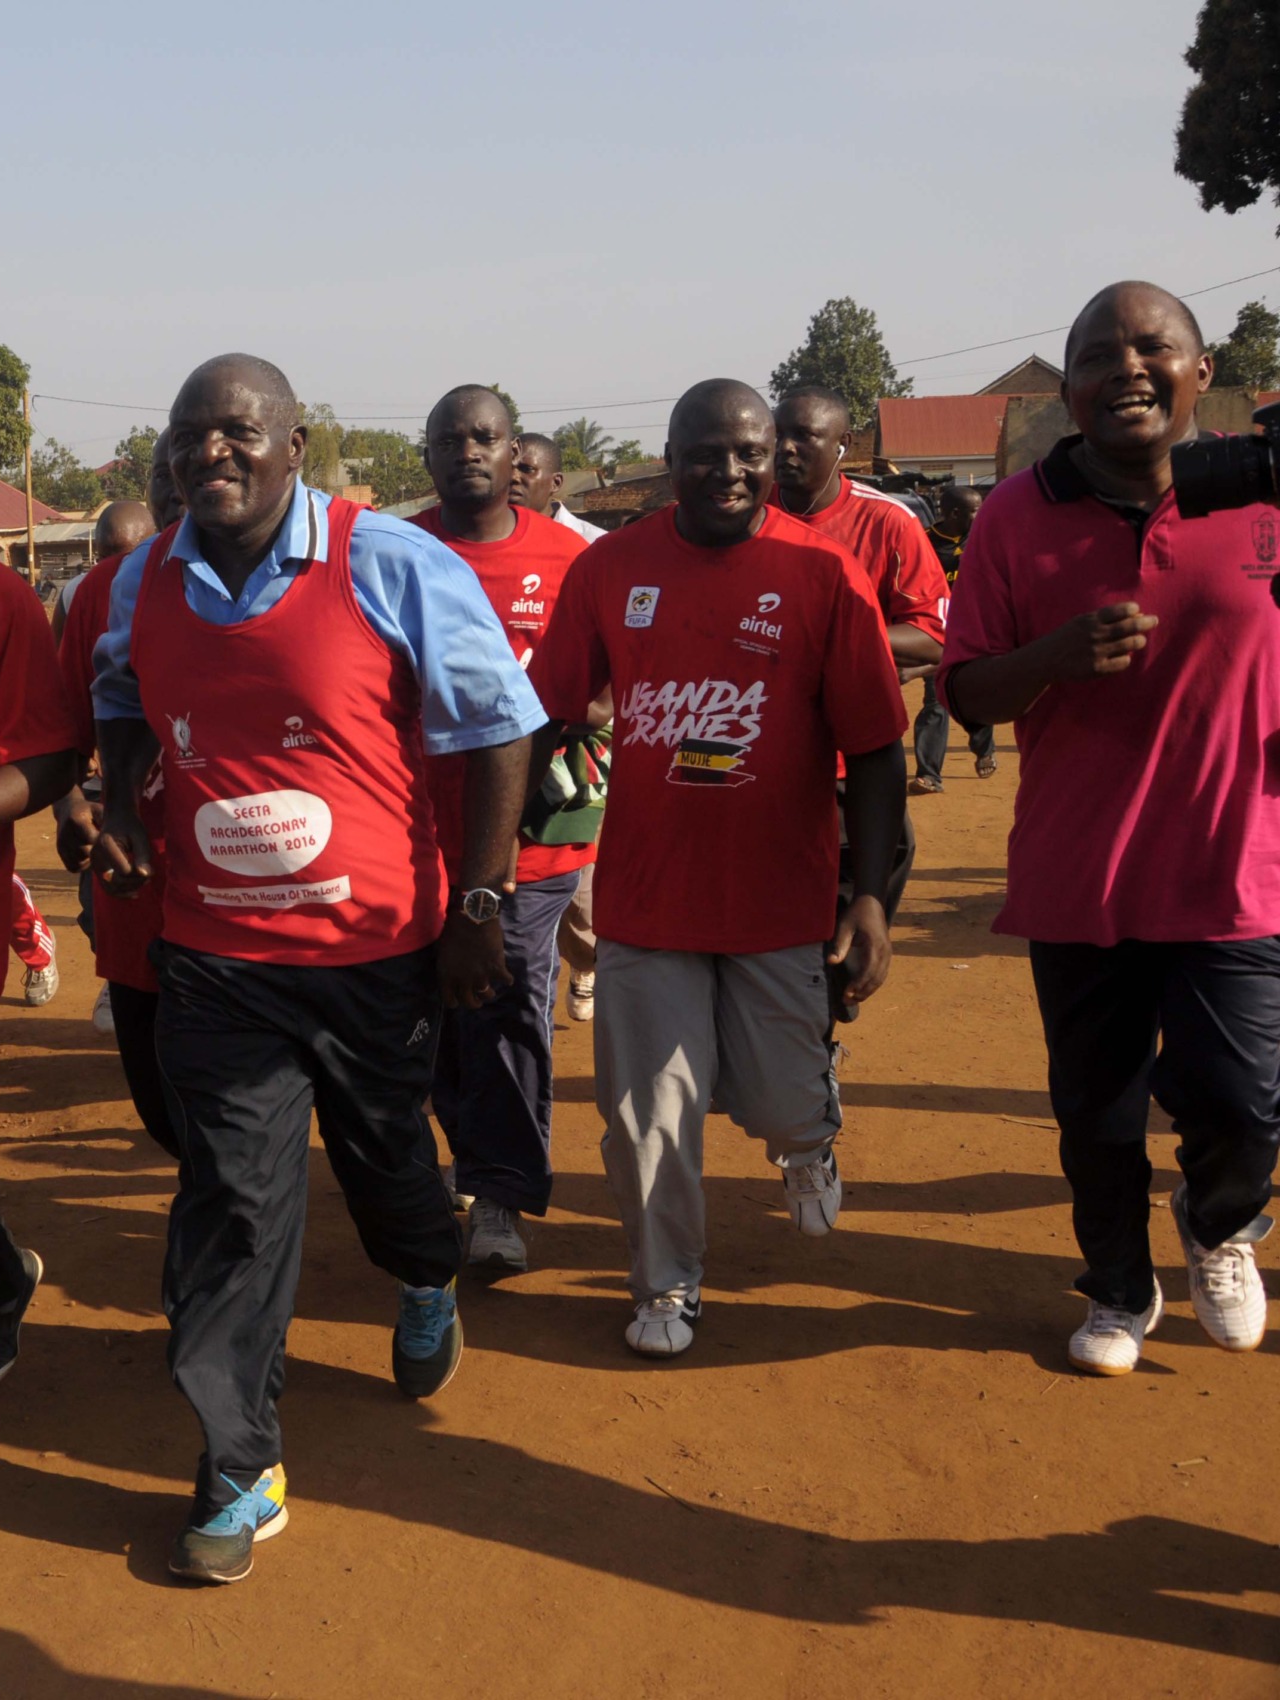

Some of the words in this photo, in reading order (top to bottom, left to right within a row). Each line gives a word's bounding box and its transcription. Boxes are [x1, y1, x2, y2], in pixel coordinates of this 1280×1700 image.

[511, 598, 544, 614] airtel
[628, 617, 647, 625] FUFA
[740, 615, 783, 640] airtel
[620, 677, 769, 719] UGANDA
[681, 752, 712, 767] MUJJE
[234, 804, 271, 820] SEETA
[210, 817, 307, 839] ARCHDEACONRY
[210, 842, 278, 856] MARATHON
[285, 835, 316, 851] 2016
[241, 892, 258, 901] The
[258, 891, 286, 902] House
[288, 889, 300, 900] Of
[301, 888, 318, 898] The
[320, 884, 340, 896] Lord
